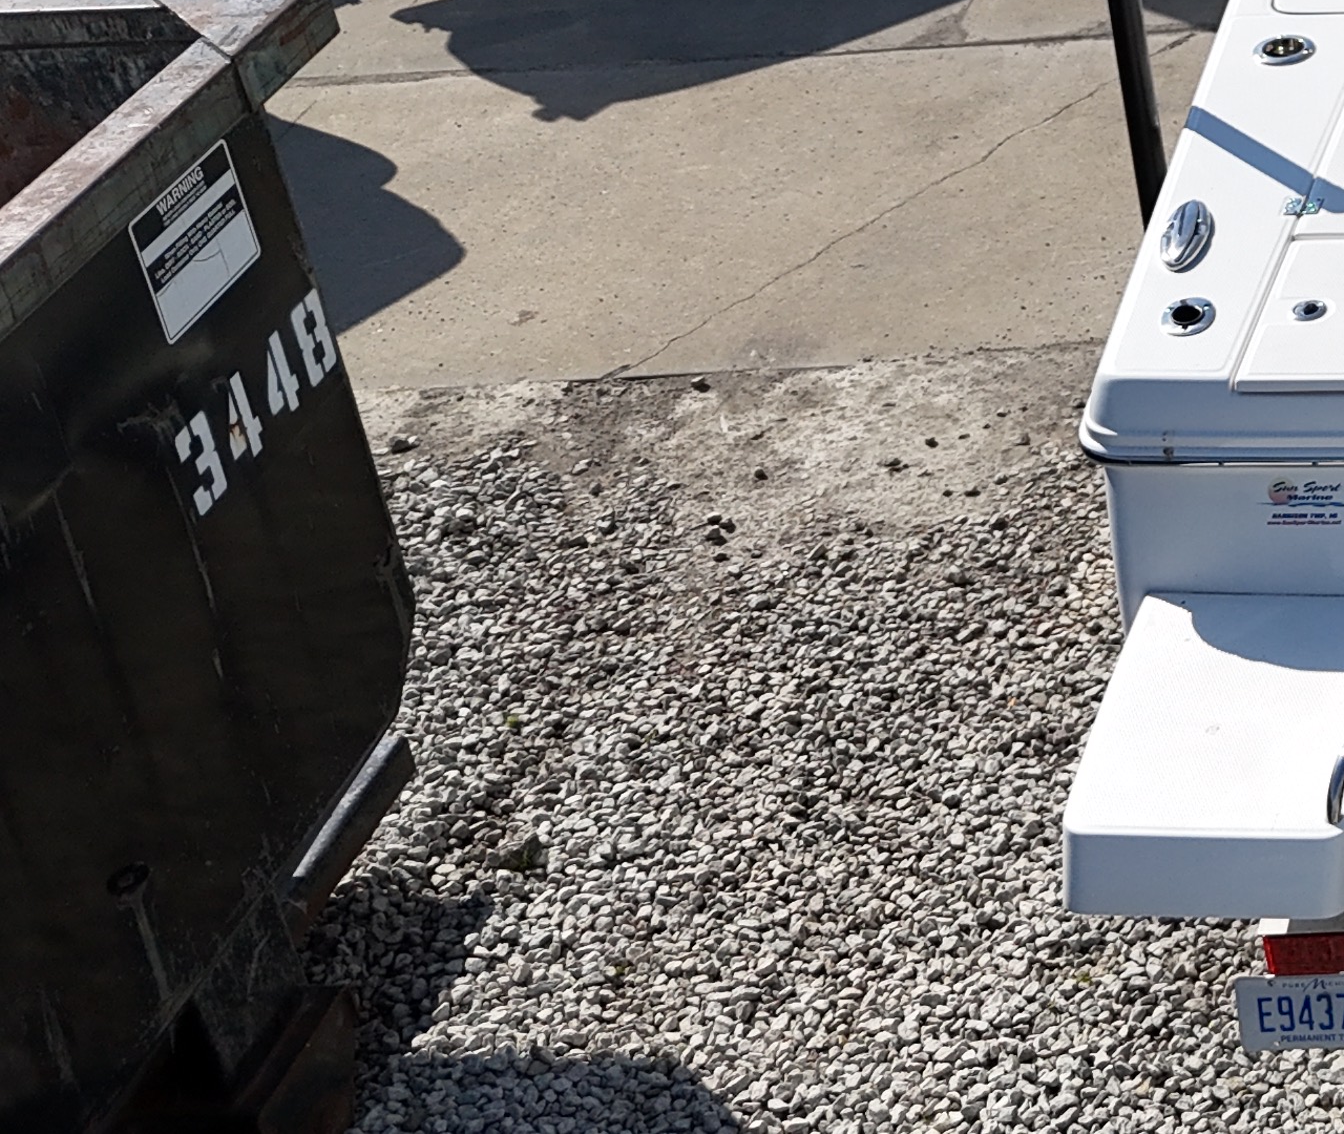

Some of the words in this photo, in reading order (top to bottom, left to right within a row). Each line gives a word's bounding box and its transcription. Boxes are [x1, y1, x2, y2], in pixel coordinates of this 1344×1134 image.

[155, 166, 205, 217] WARNING
[174, 287, 337, 516] 3448
[1272, 480, 1299, 493] Sun
[1302, 480, 1342, 494] Sport
[1280, 1033, 1336, 1043] PERMANENT
